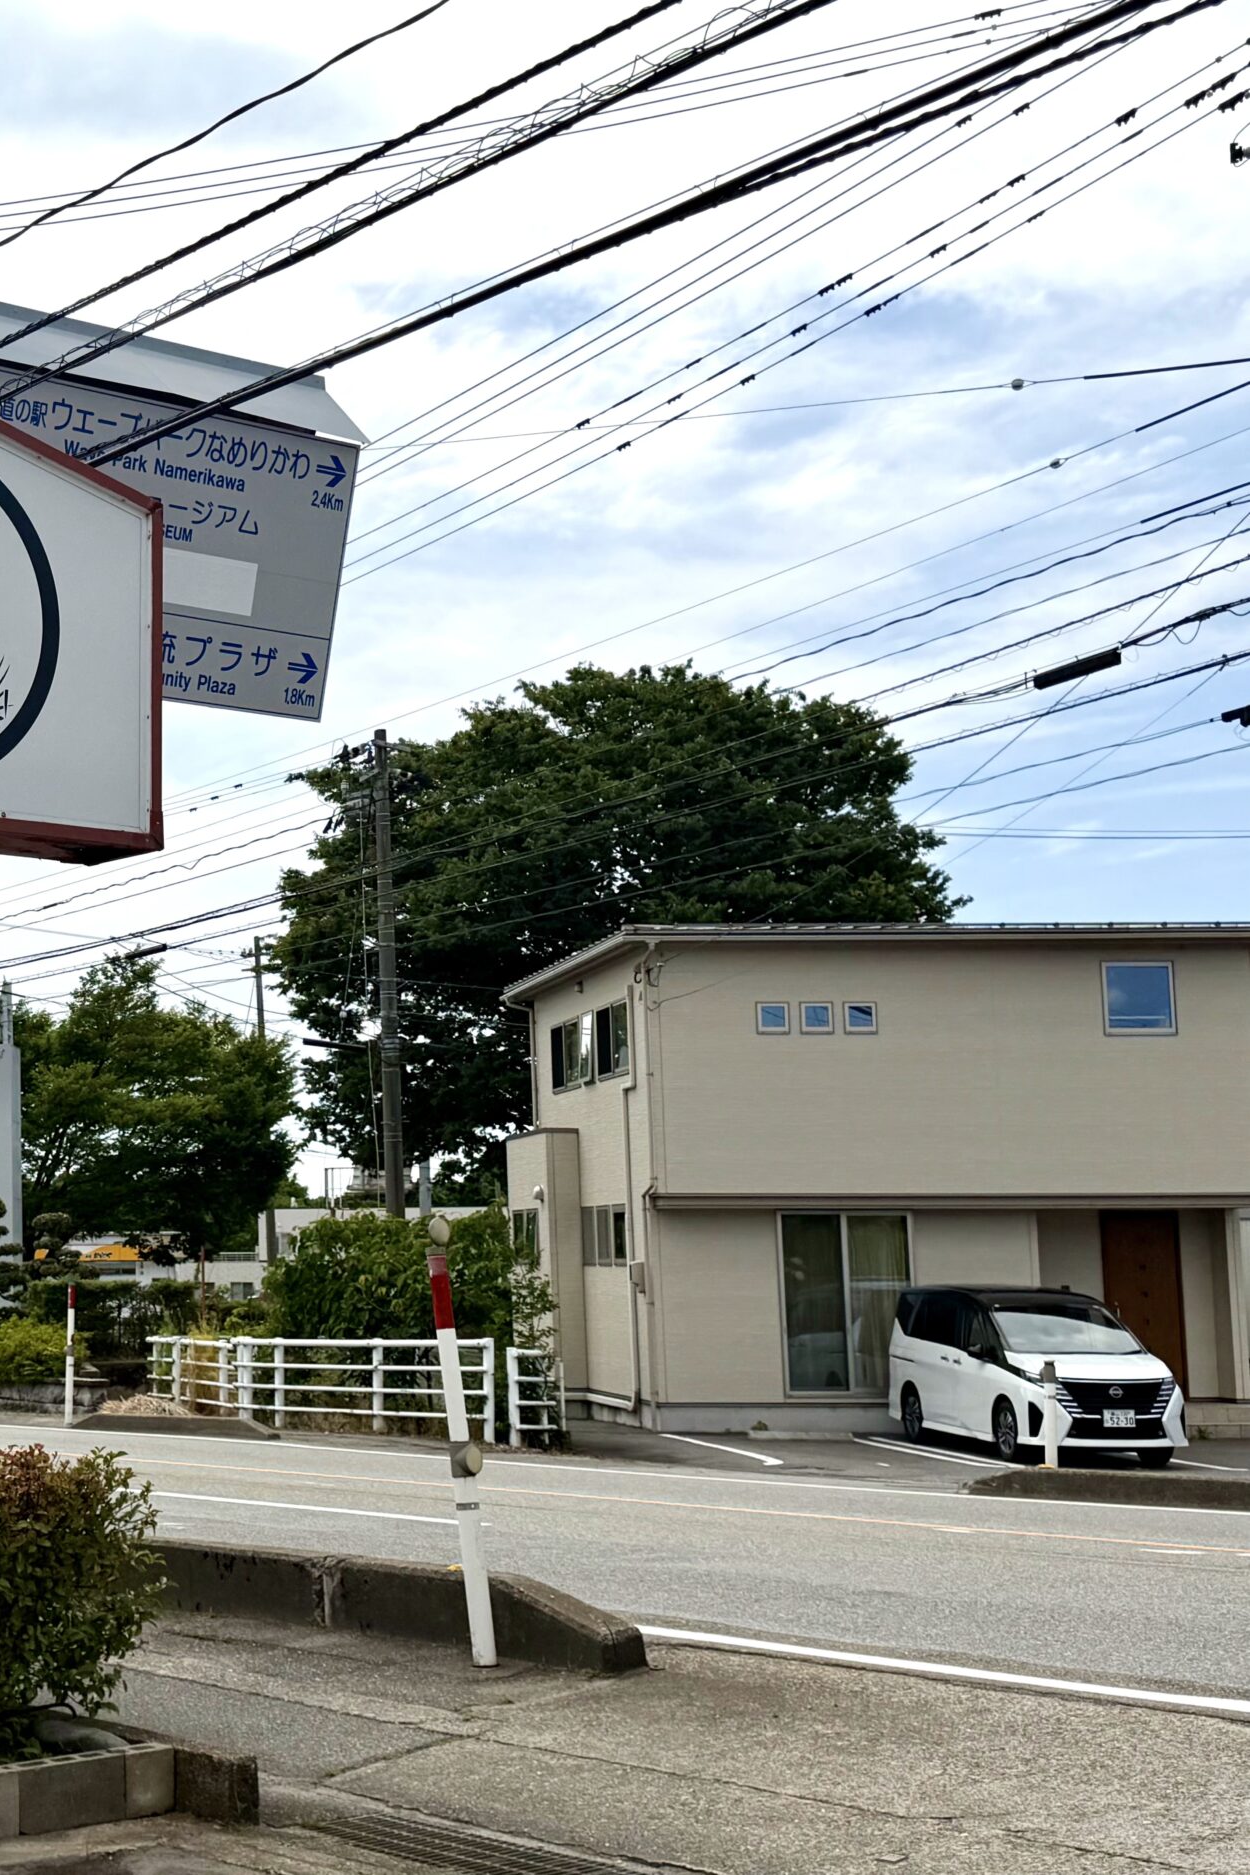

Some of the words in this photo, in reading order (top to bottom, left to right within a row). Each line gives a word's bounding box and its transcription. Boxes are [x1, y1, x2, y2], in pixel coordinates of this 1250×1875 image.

[154, 457, 246, 492] Namerikawa
[152, 496, 259, 535] ージアム
[162, 524, 193, 542] EUM
[197, 674, 236, 696] Plaza
